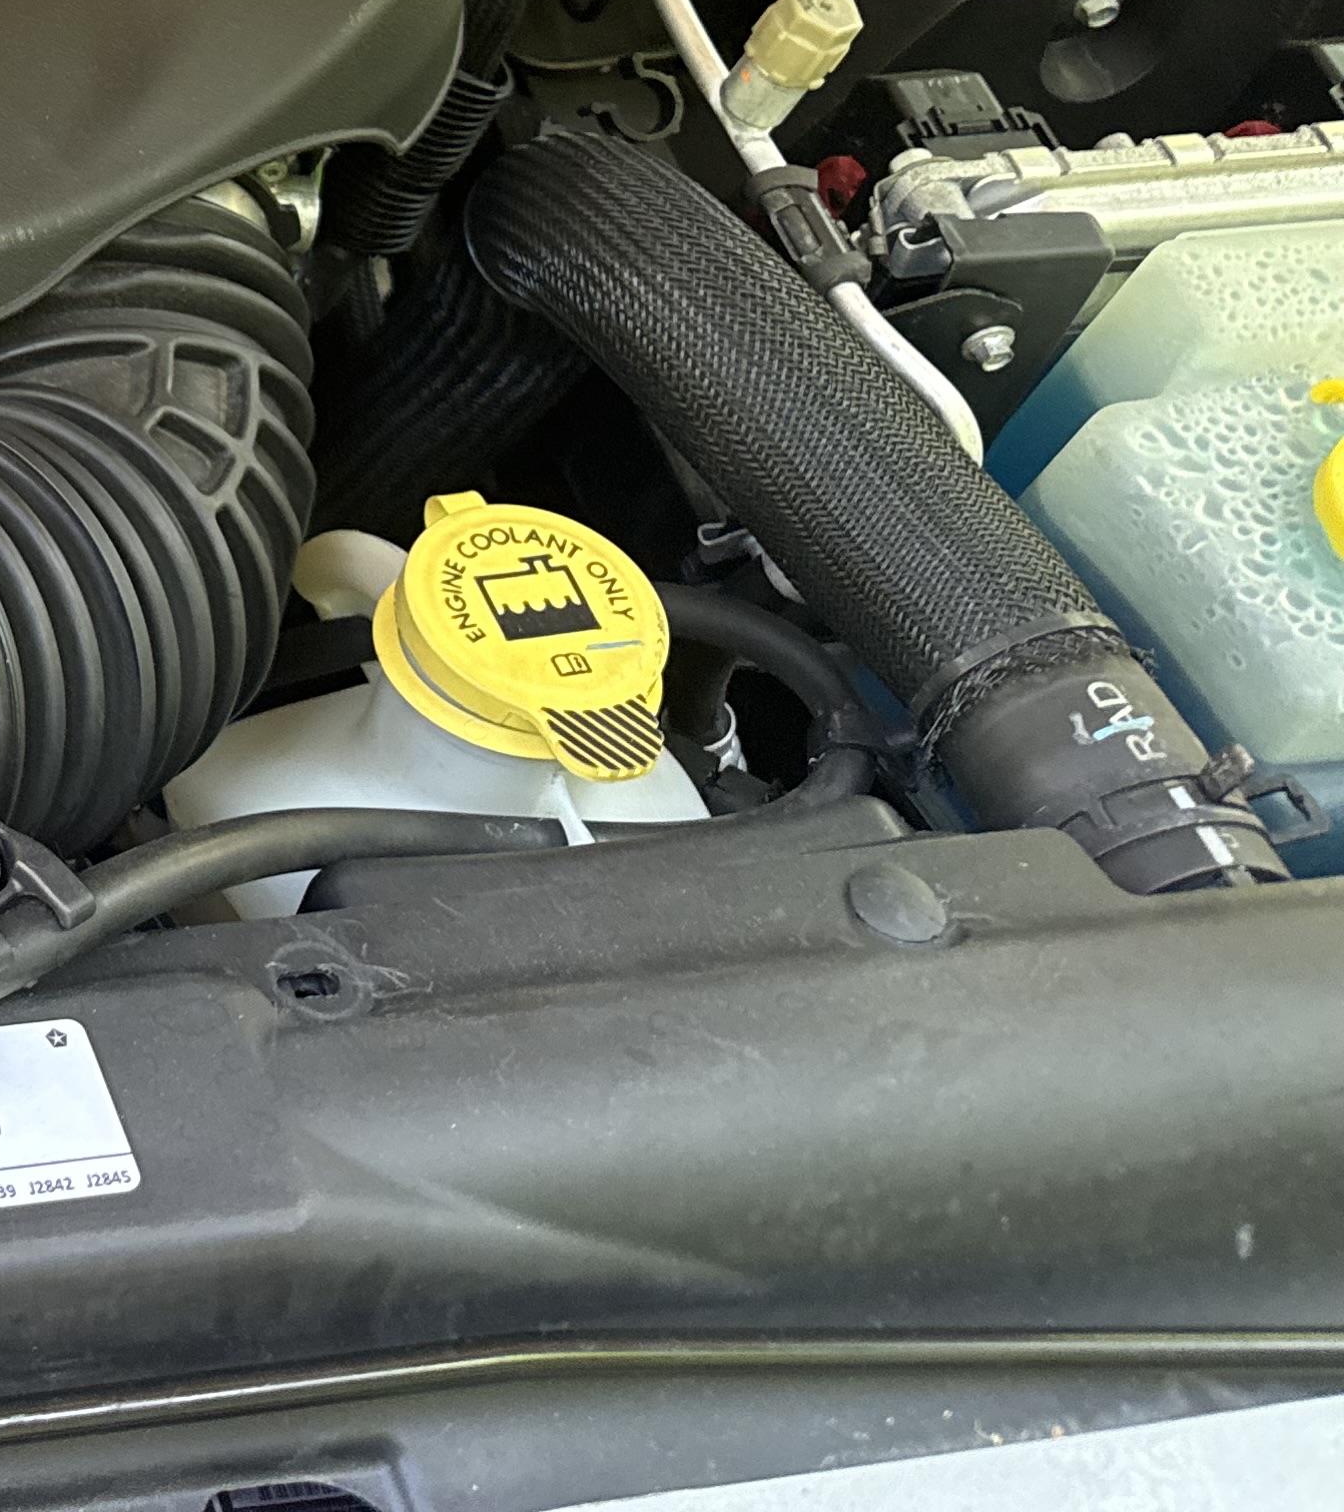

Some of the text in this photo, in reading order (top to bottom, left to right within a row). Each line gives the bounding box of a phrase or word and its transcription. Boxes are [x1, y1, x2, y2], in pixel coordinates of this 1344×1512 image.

[441, 526, 636, 643] ENGINE COOLANT ONLY
[27, 1176, 76, 1196] J2842
[85, 1168, 132, 1189] J2845
